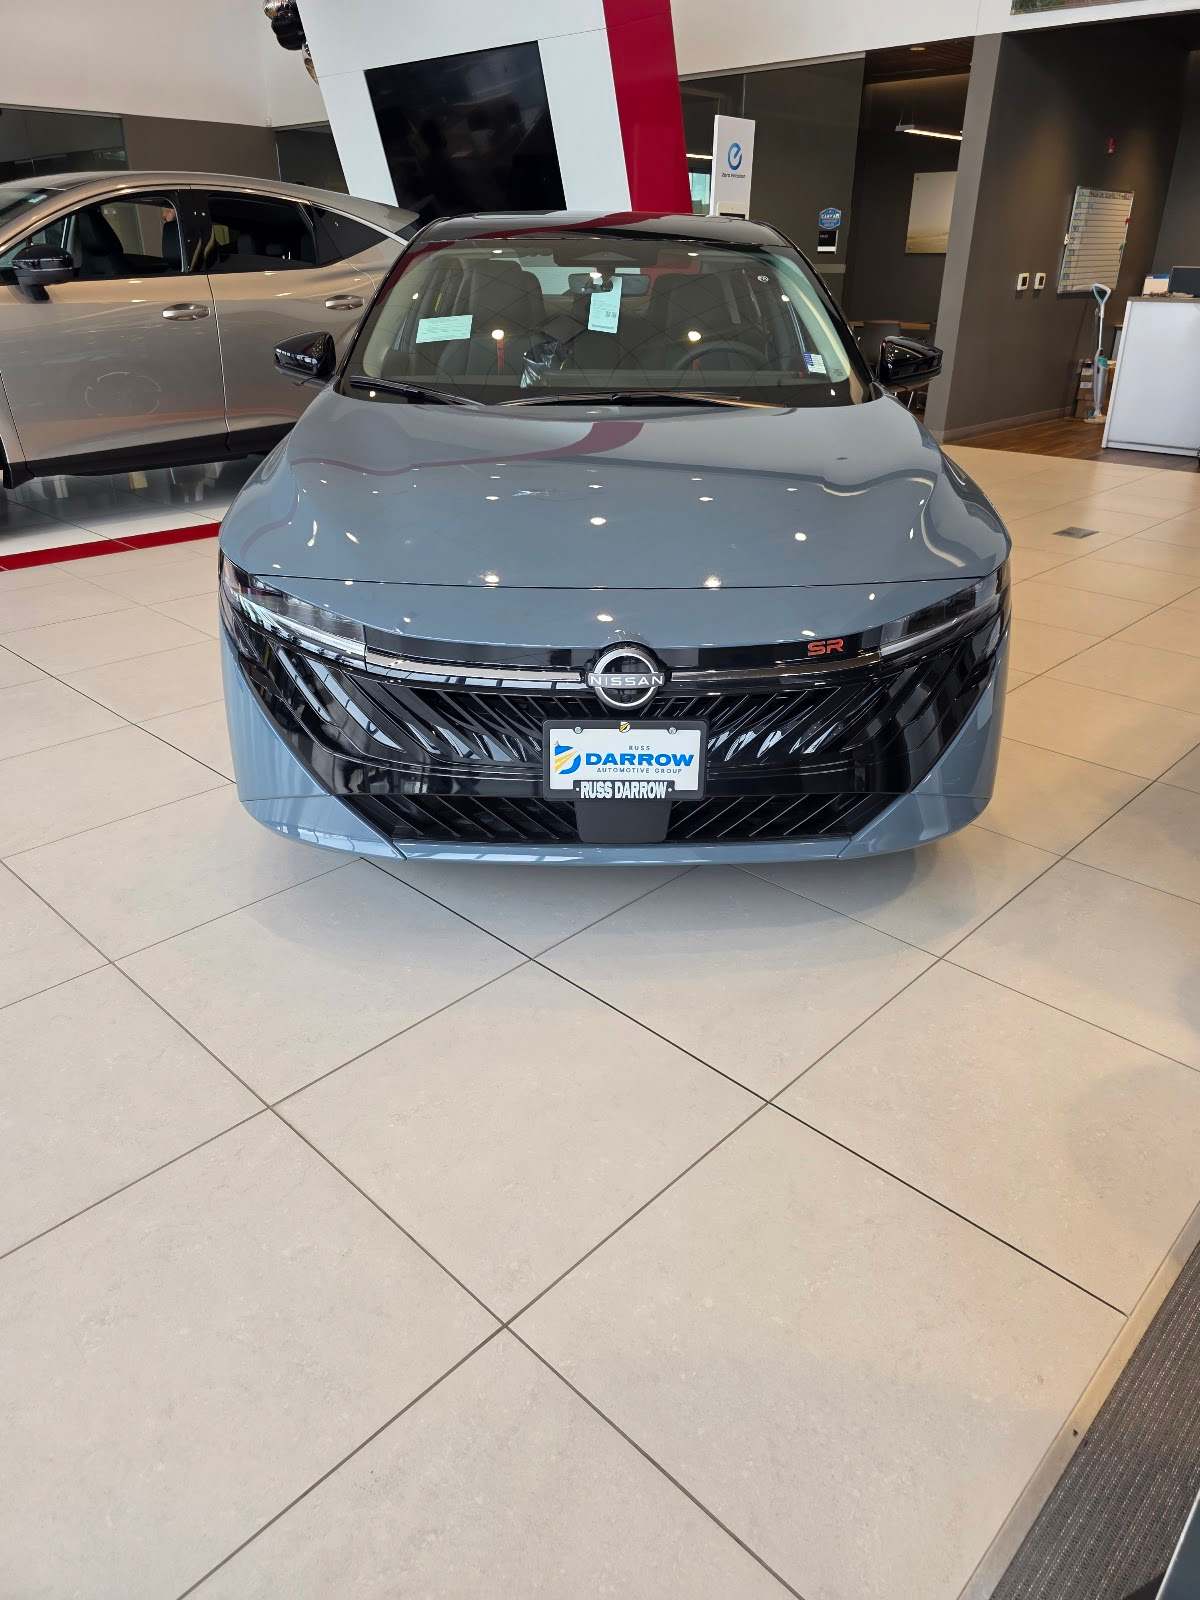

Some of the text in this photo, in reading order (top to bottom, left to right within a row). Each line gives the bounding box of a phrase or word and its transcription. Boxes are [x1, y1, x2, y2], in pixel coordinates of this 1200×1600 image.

[808, 639, 844, 656] SR
[590, 675, 663, 686] NISSAN
[585, 752, 694, 767] DARROW
[580, 781, 667, 799] RUSS DARROW
